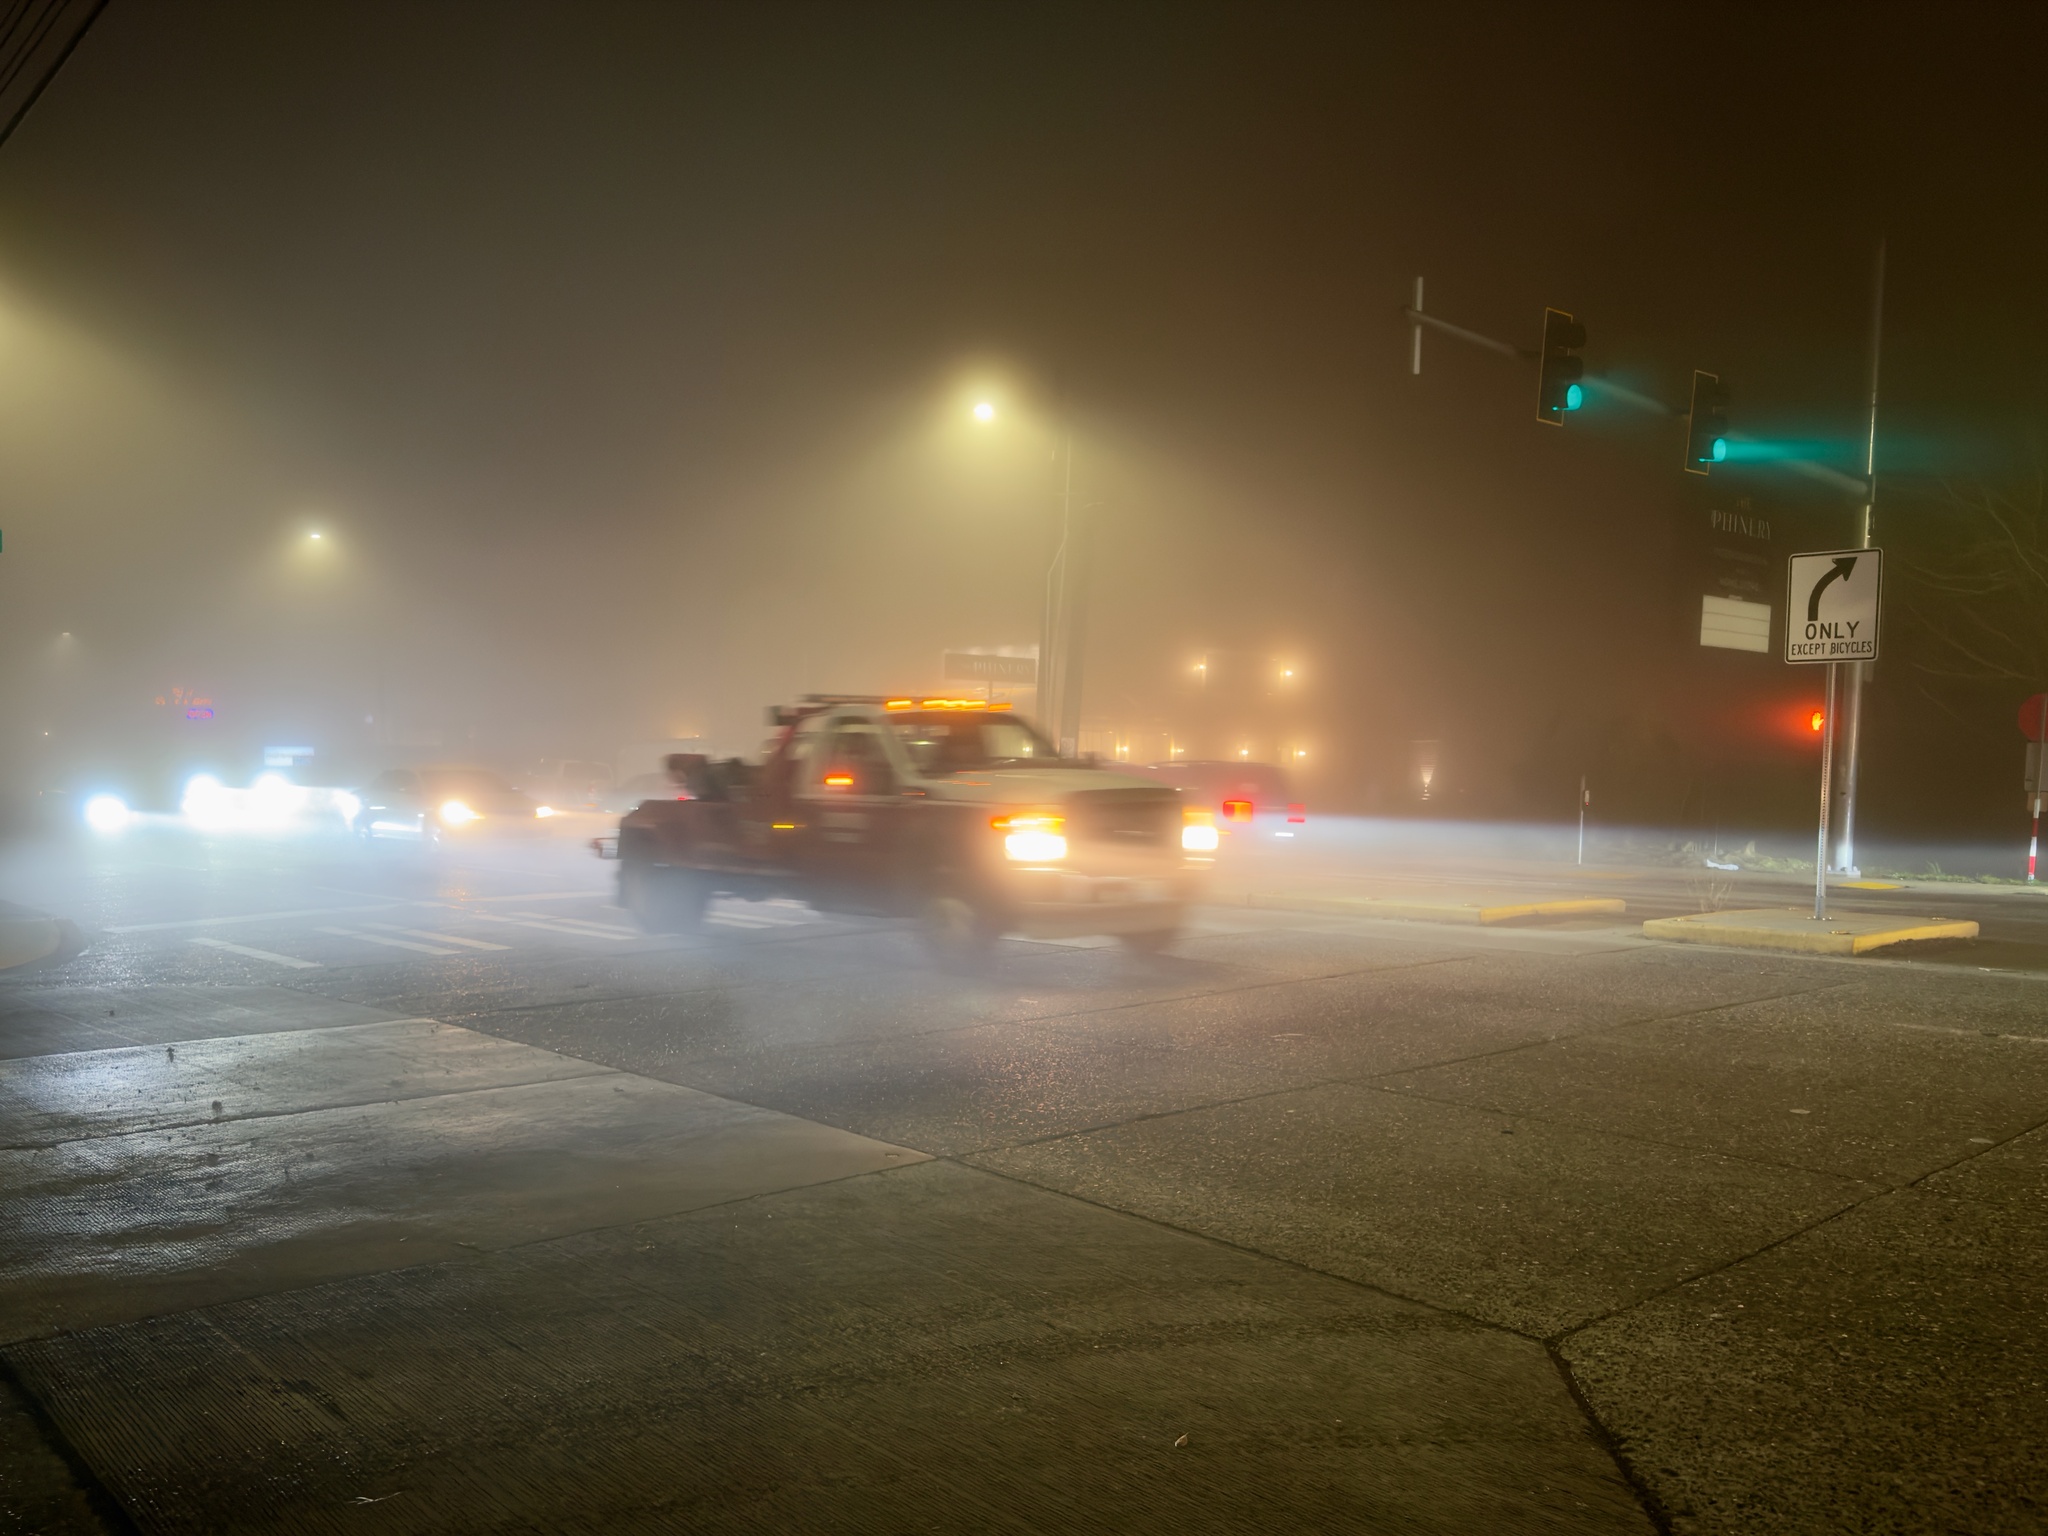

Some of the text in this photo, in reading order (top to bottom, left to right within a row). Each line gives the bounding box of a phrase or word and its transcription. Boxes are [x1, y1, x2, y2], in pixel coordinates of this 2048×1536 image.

[1805, 621, 1860, 640] ONLY
[1791, 641, 1873, 655] EXCEPT BICYCLES
